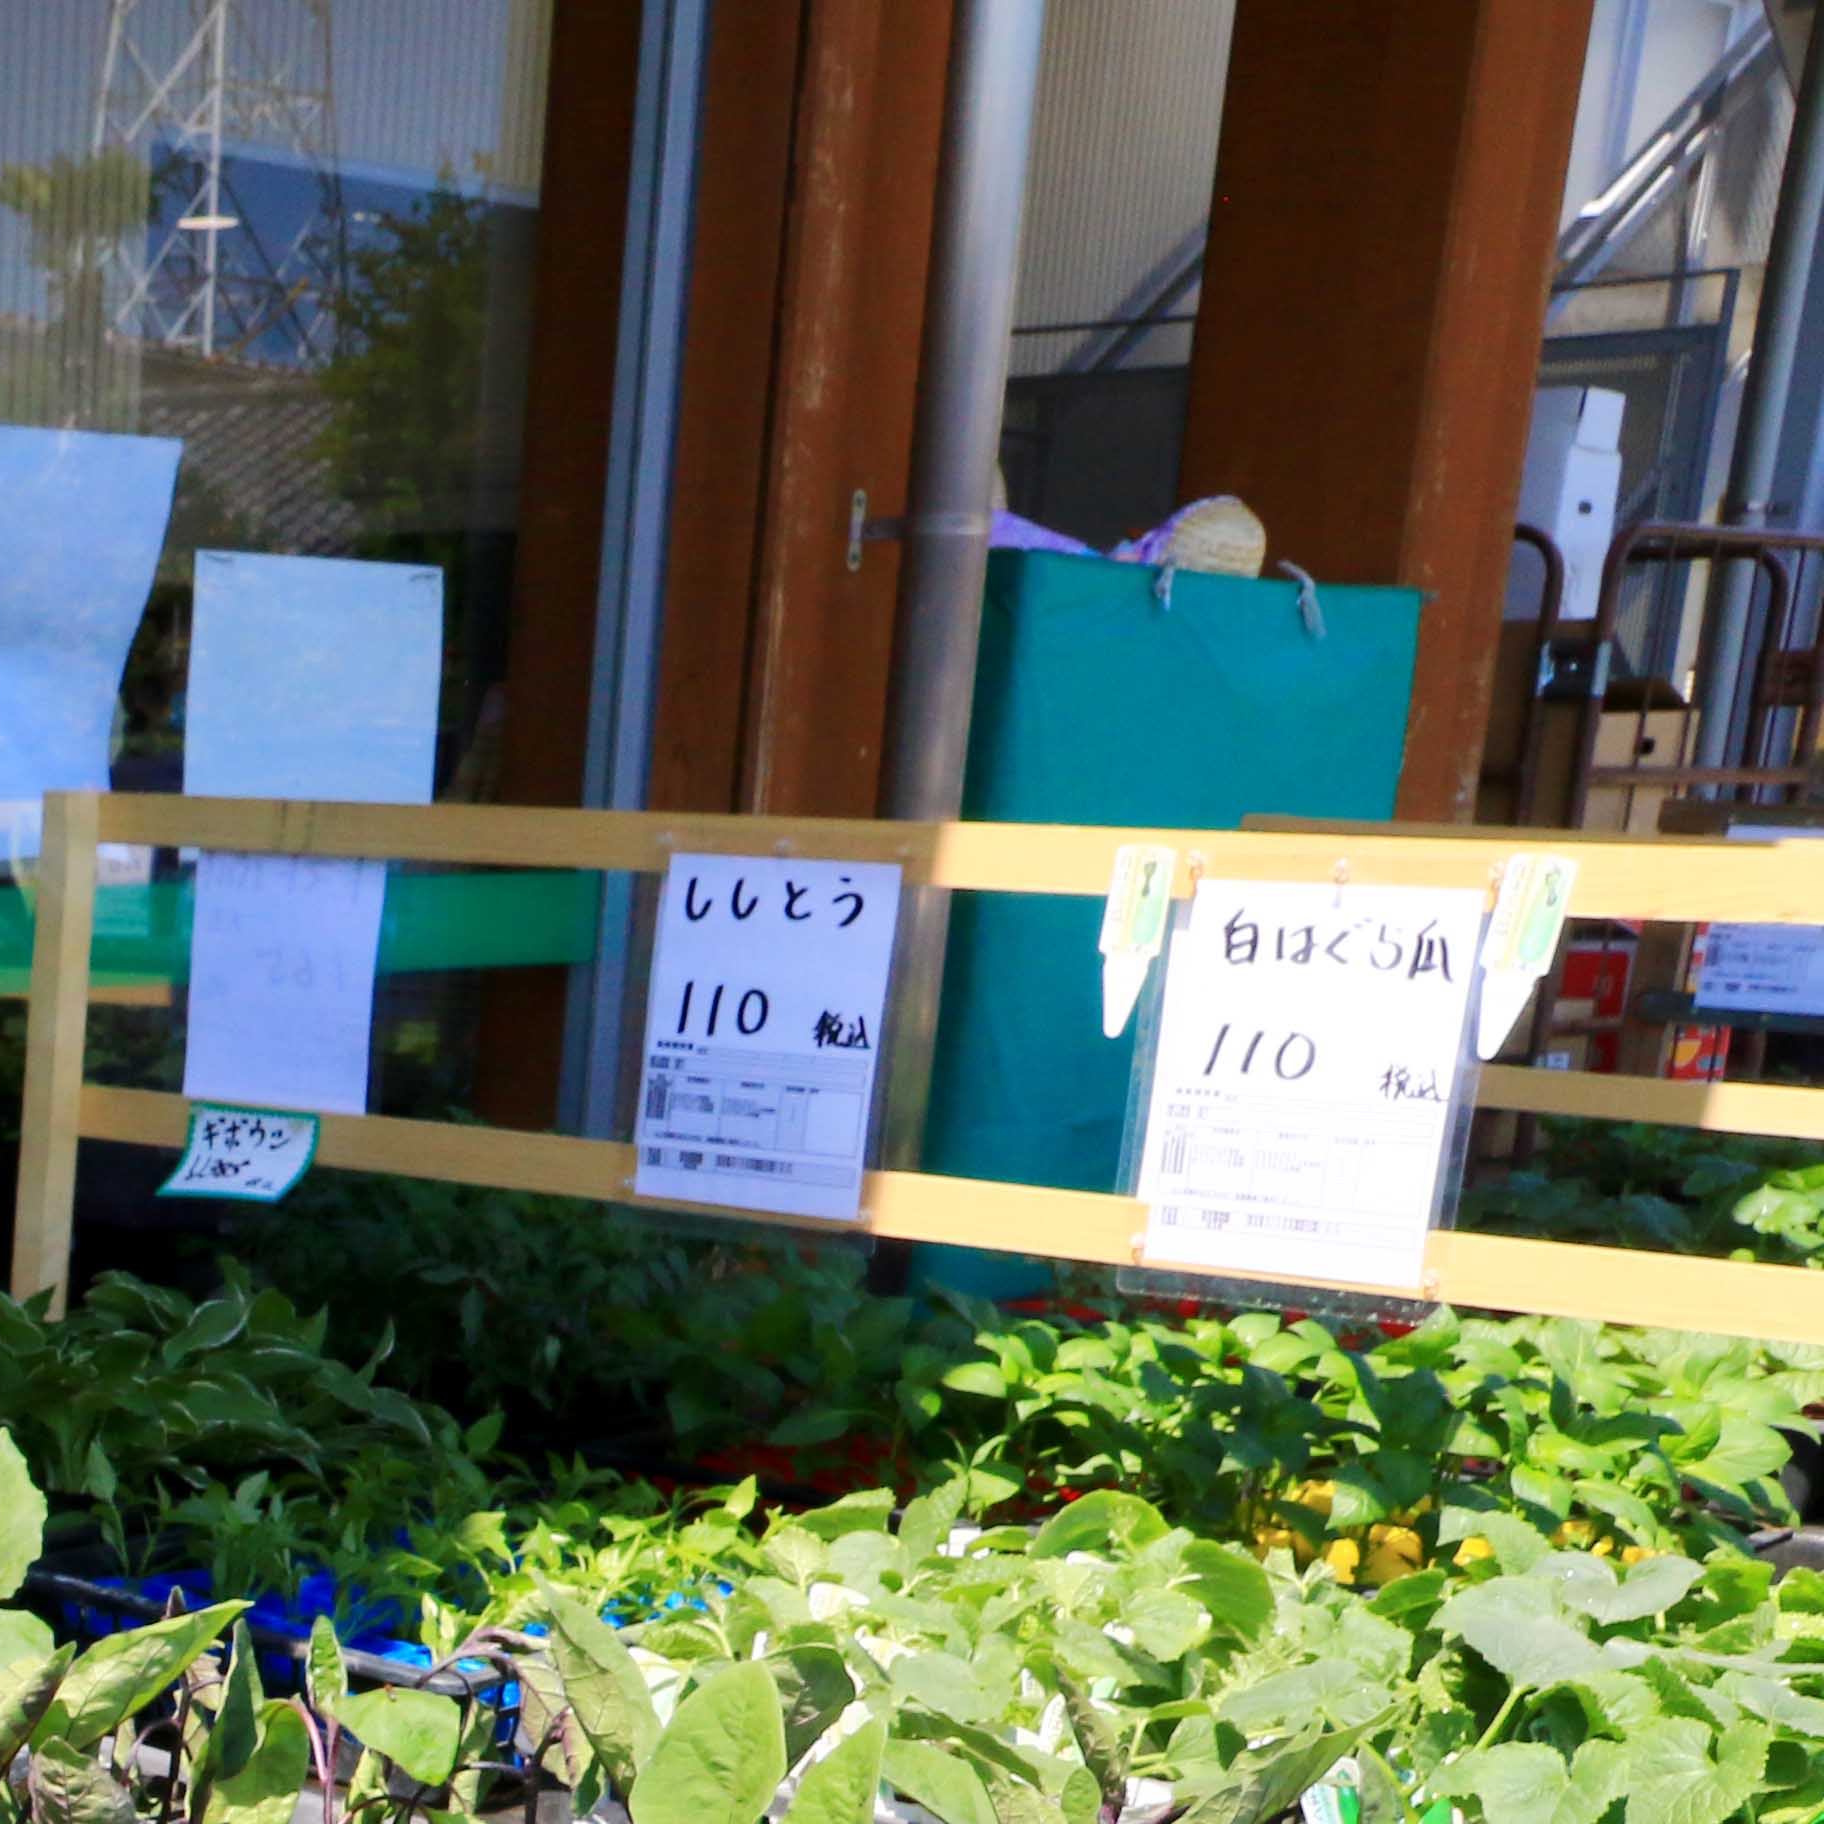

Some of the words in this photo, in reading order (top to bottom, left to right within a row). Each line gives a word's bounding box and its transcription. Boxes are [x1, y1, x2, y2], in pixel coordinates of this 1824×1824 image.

[684, 876, 866, 928] ししとう
[1222, 907, 1454, 984] 白はぐら瓜
[676, 981, 770, 1038] 110
[812, 1009, 872, 1050] 税込
[1202, 1023, 1318, 1081] 110
[1378, 1064, 1452, 1103] 税込
